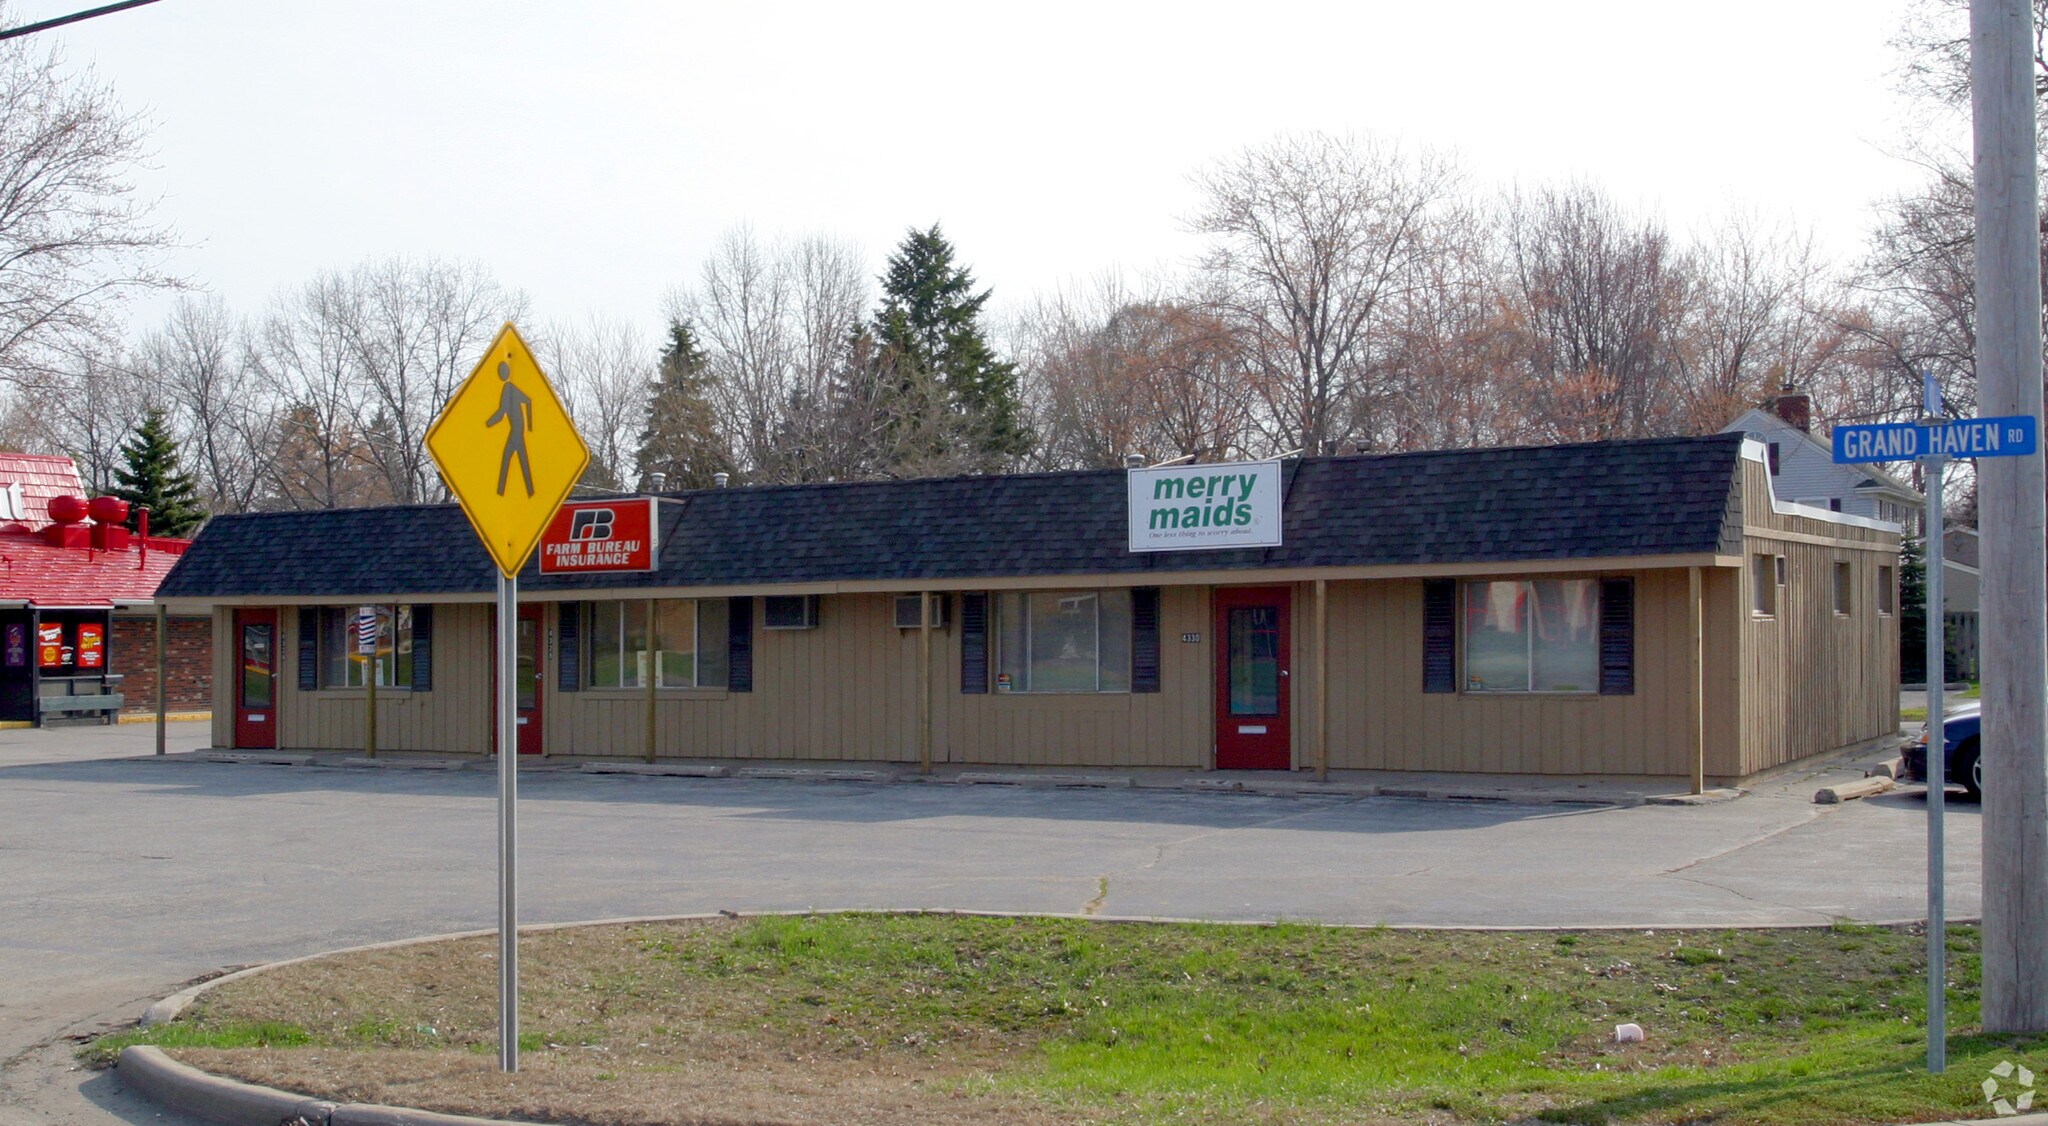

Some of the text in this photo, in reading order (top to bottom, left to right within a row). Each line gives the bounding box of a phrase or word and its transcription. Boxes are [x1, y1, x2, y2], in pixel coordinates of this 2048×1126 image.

[1843, 423, 2023, 459] GRAND HAVEN RD
[1153, 473, 1257, 502] merry
[1149, 497, 1253, 529] maids
[1178, 530, 1197, 538] thing
[1206, 529, 1228, 537] worry
[546, 540, 640, 555] FARM BUREAU
[556, 553, 630, 567] INSURANCE
